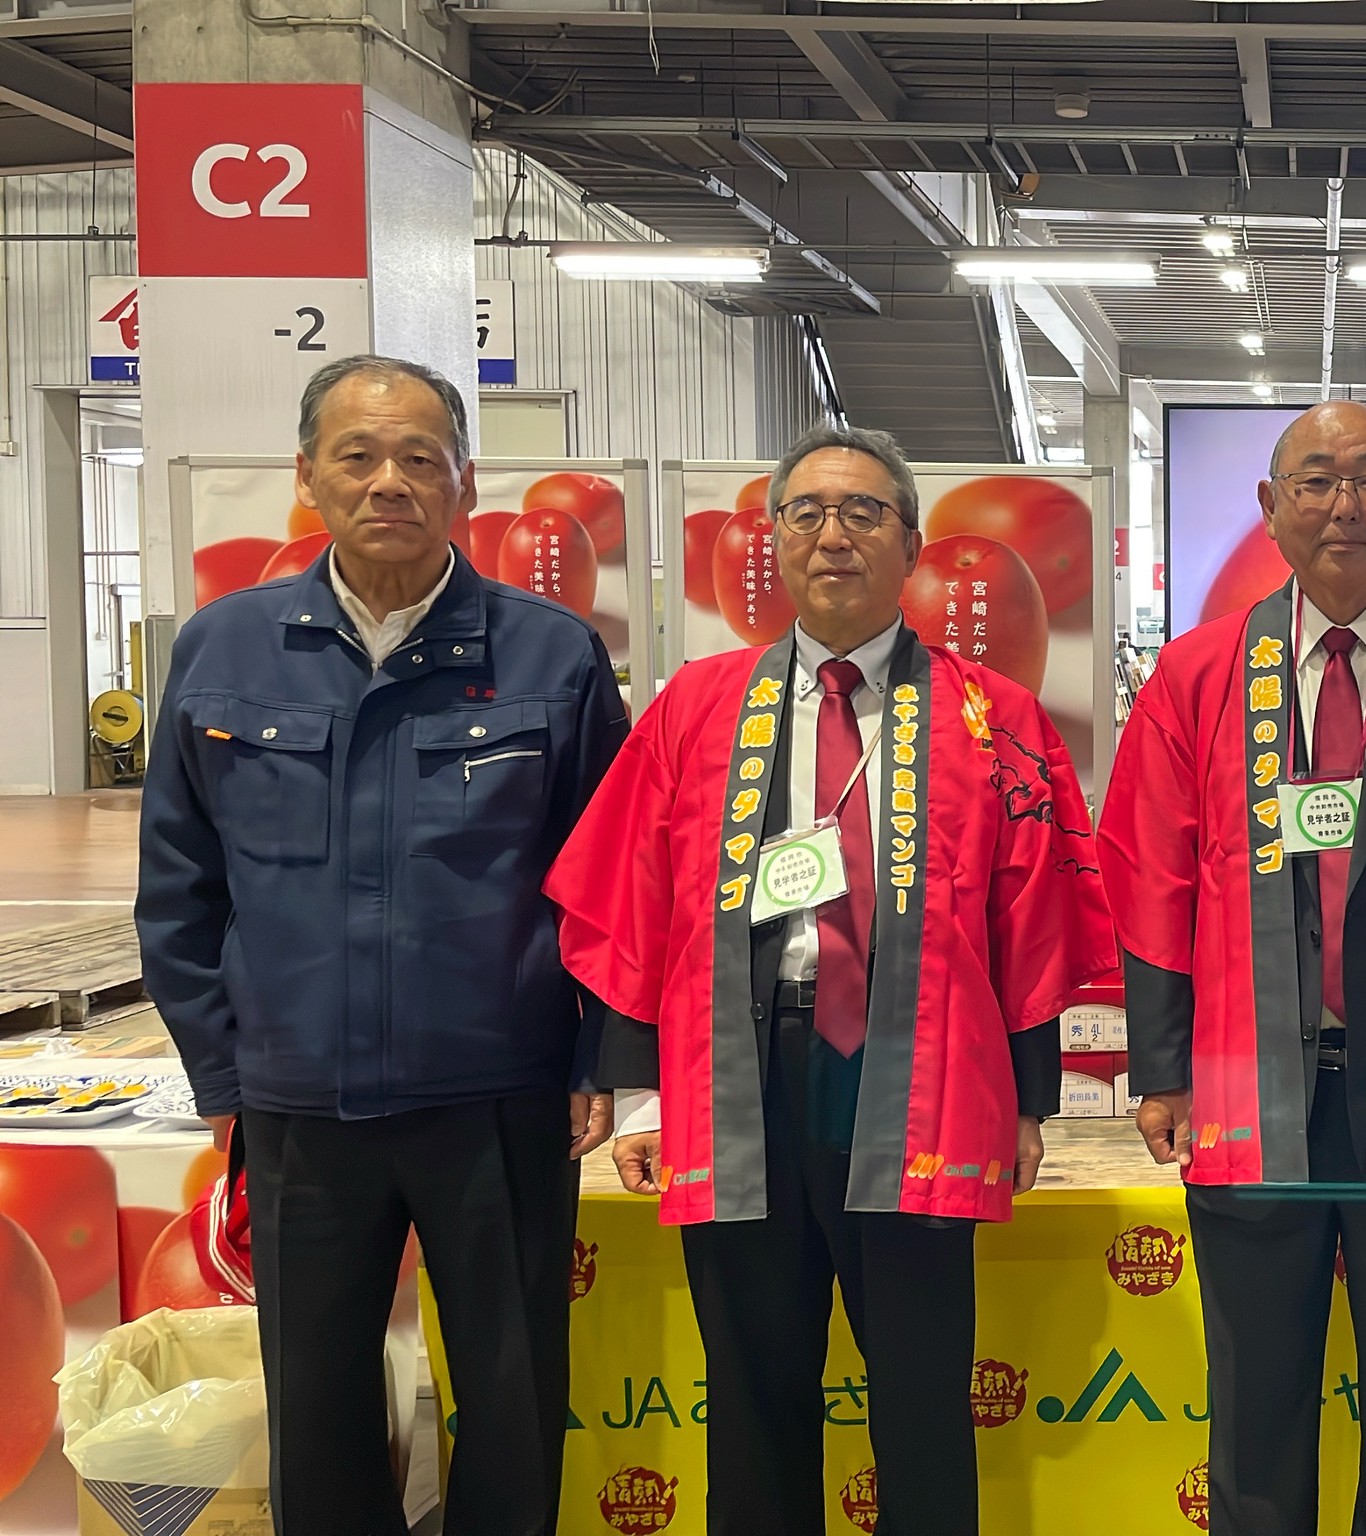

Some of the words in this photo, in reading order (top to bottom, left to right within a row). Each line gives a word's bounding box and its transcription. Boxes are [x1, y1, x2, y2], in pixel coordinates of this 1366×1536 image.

[191, 143, 310, 218] C2
[274, 306, 327, 351] -2
[534, 535, 546, 598] できた美味
[971, 581, 988, 665] 宮崎だか
[1249, 635, 1285, 875] 太陽のタマゴ
[720, 677, 783, 912] 太陽のタマゴ
[1307, 811, 1351, 825] 見学者之証
[1071, 1025, 1082, 1037] 秀
[1117, 1272, 1174, 1286] みやざき
[610, 1512, 667, 1527] みやざき
